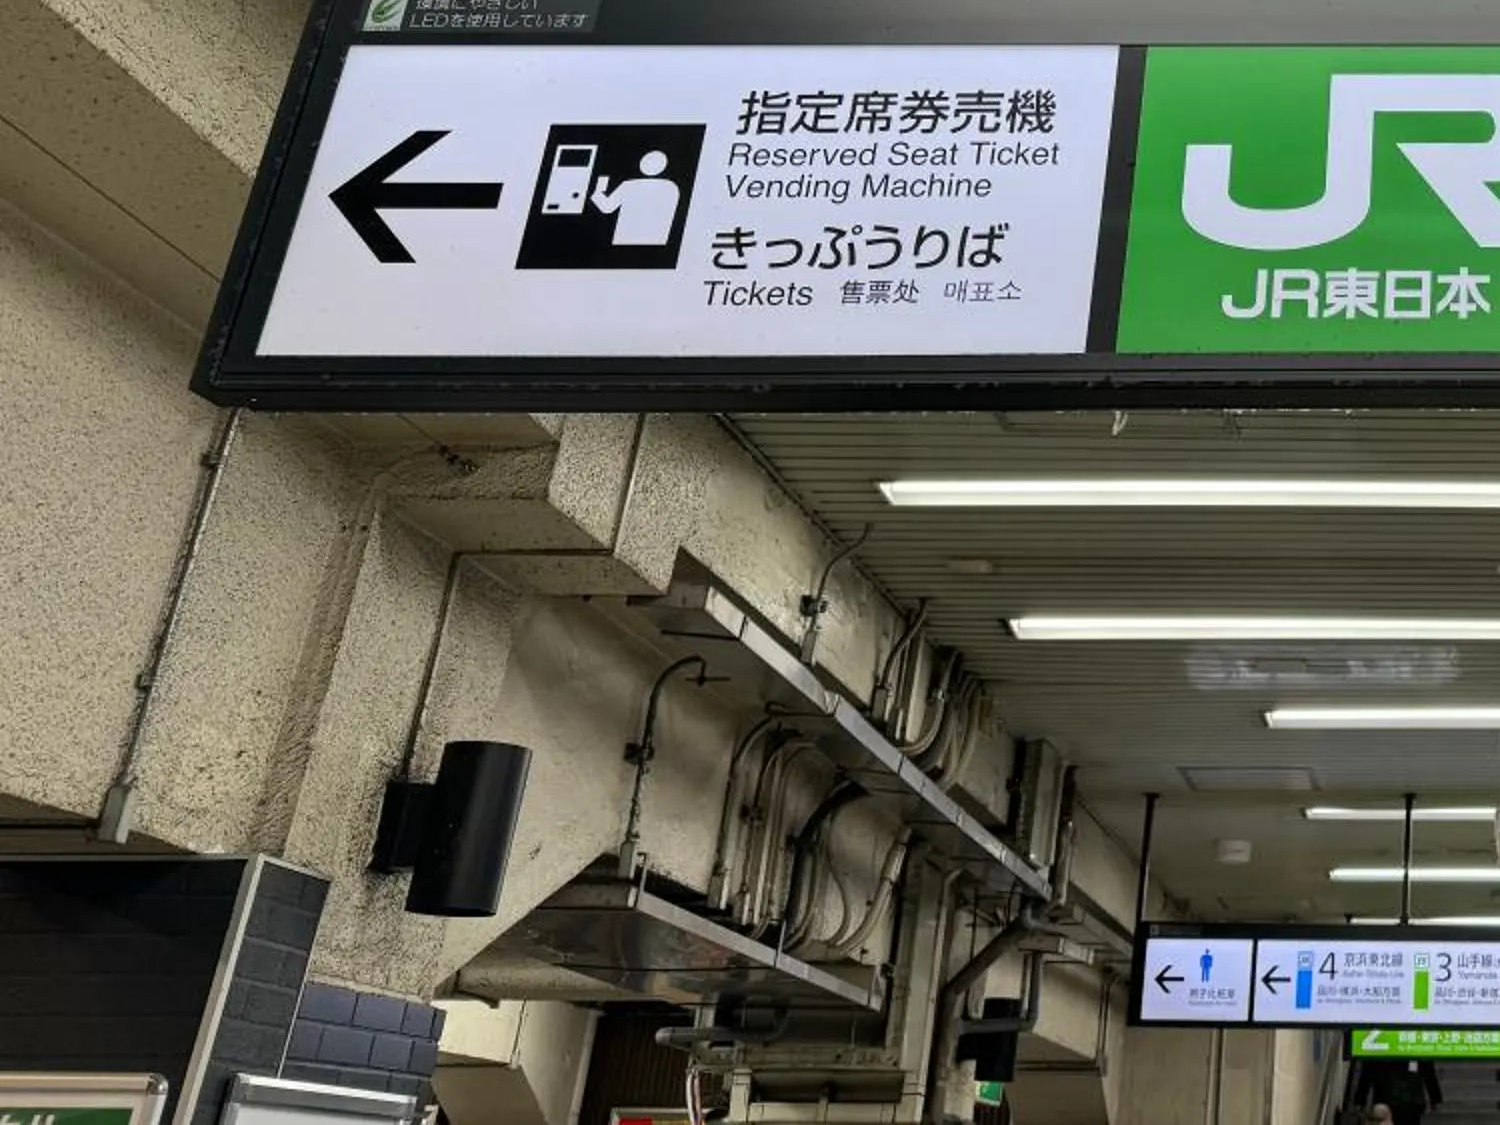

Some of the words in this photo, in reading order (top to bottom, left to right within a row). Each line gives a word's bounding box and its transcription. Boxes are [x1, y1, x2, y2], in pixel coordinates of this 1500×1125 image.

[408, 13, 589, 29] LEDを使用しています
[736, 90, 1058, 136] 指定席券売機
[728, 142, 878, 166] Reserved
[888, 141, 958, 166] Seat
[970, 141, 1060, 166] Ticket
[726, 173, 850, 204] Vending
[861, 173, 992, 198] Machine
[711, 222, 1010, 270] きっぷうりば
[703, 280, 814, 306] Tickets
[839, 279, 920, 305] 售票处
[943, 279, 1022, 304] 매표소
[1221, 267, 1491, 320] JR東日本
[1318, 951, 1338, 981] 4
[1433, 952, 1452, 982] 3
